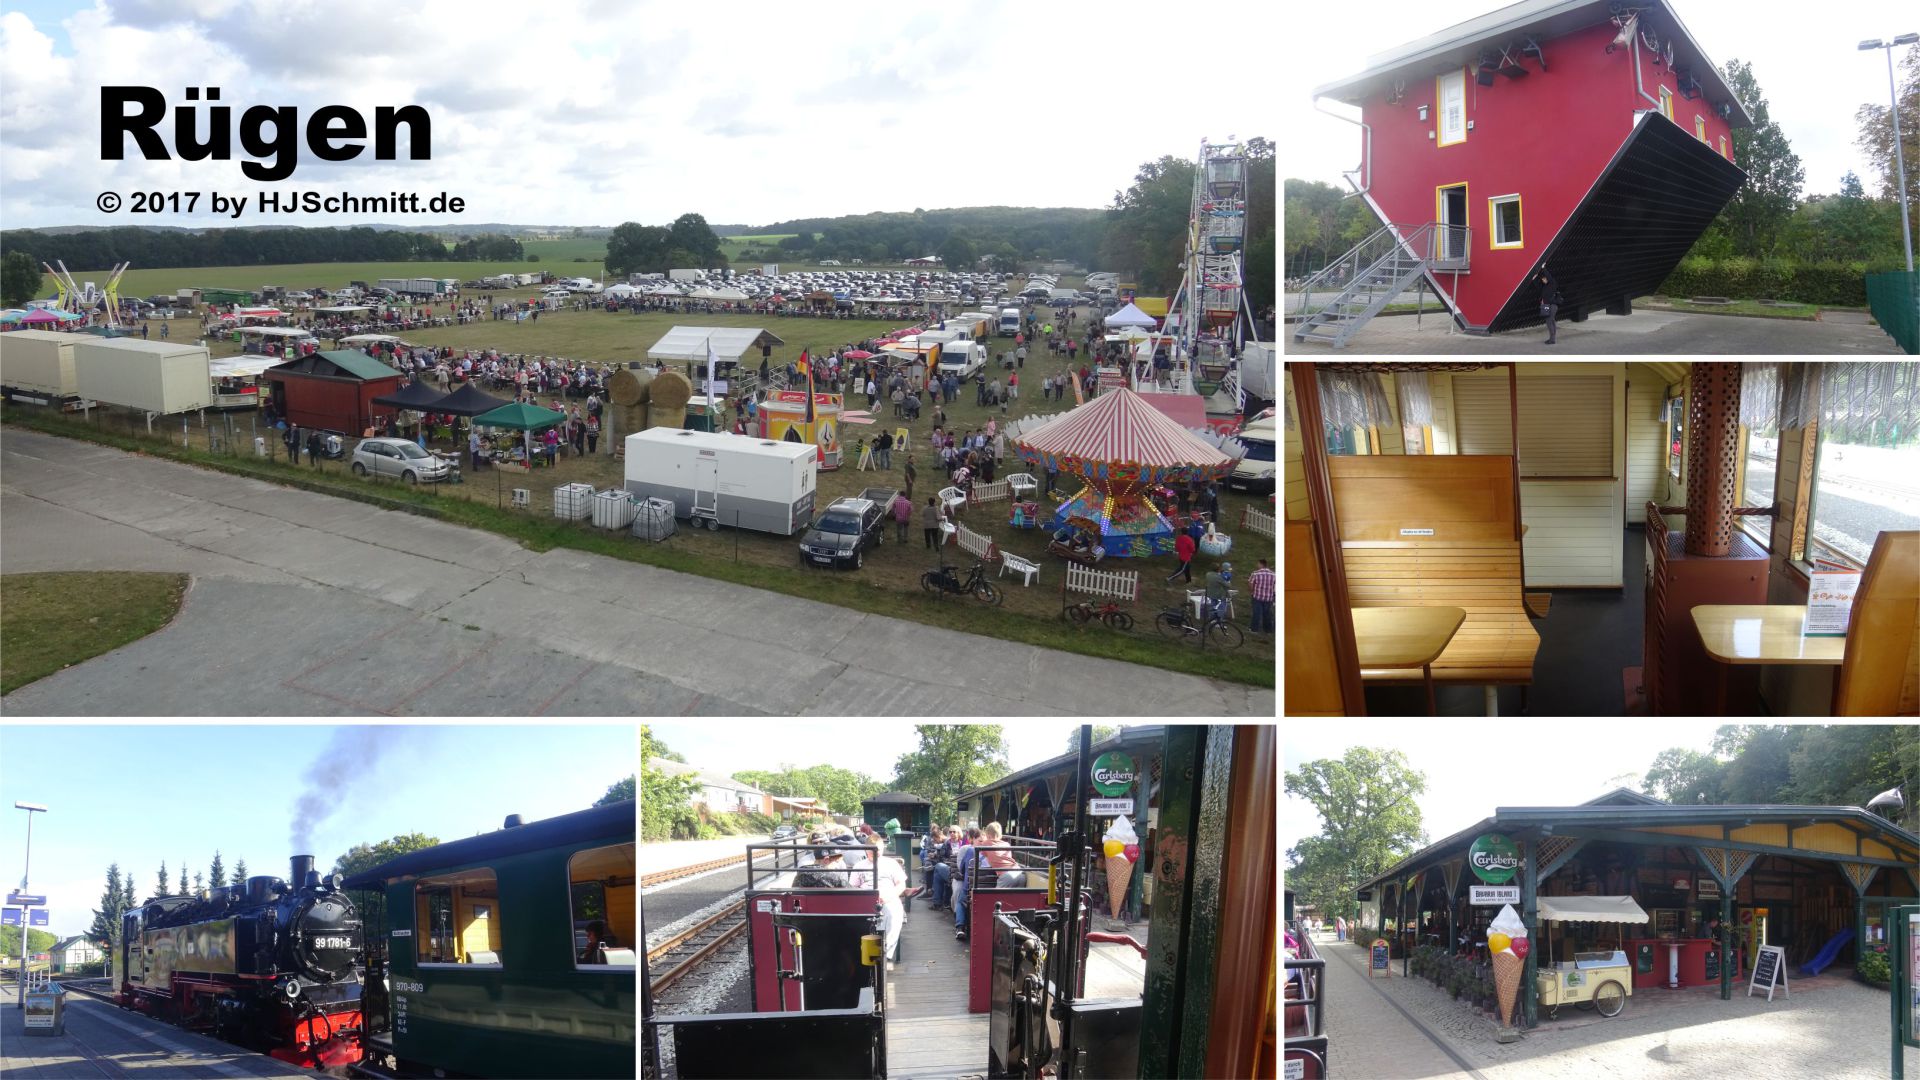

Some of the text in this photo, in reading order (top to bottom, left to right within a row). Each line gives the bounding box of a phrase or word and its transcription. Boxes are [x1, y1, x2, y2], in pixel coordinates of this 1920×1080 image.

[1095, 768, 1133, 785] Carlsberg
[1473, 851, 1518, 870] Carlsberg
[315, 937, 351, 949] 99 1781-6
[396, 982, 424, 993] 970-809
